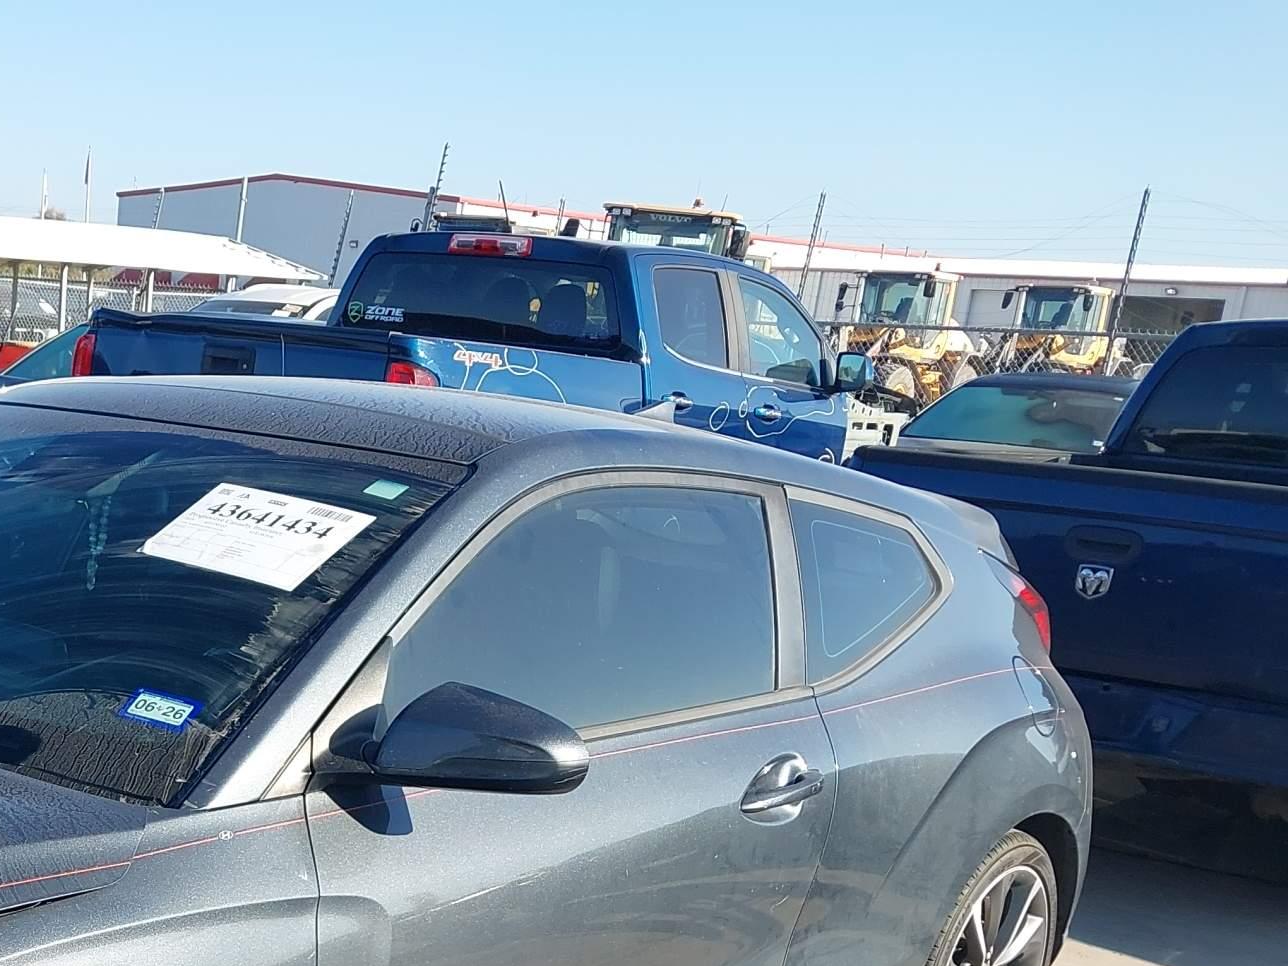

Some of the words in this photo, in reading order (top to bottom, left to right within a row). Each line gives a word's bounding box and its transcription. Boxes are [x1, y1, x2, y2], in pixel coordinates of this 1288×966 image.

[649, 213, 692, 223] VOLVO
[365, 304, 405, 317] ZONE
[364, 314, 404, 323] OFFROAD
[207, 502, 335, 540] 43641434
